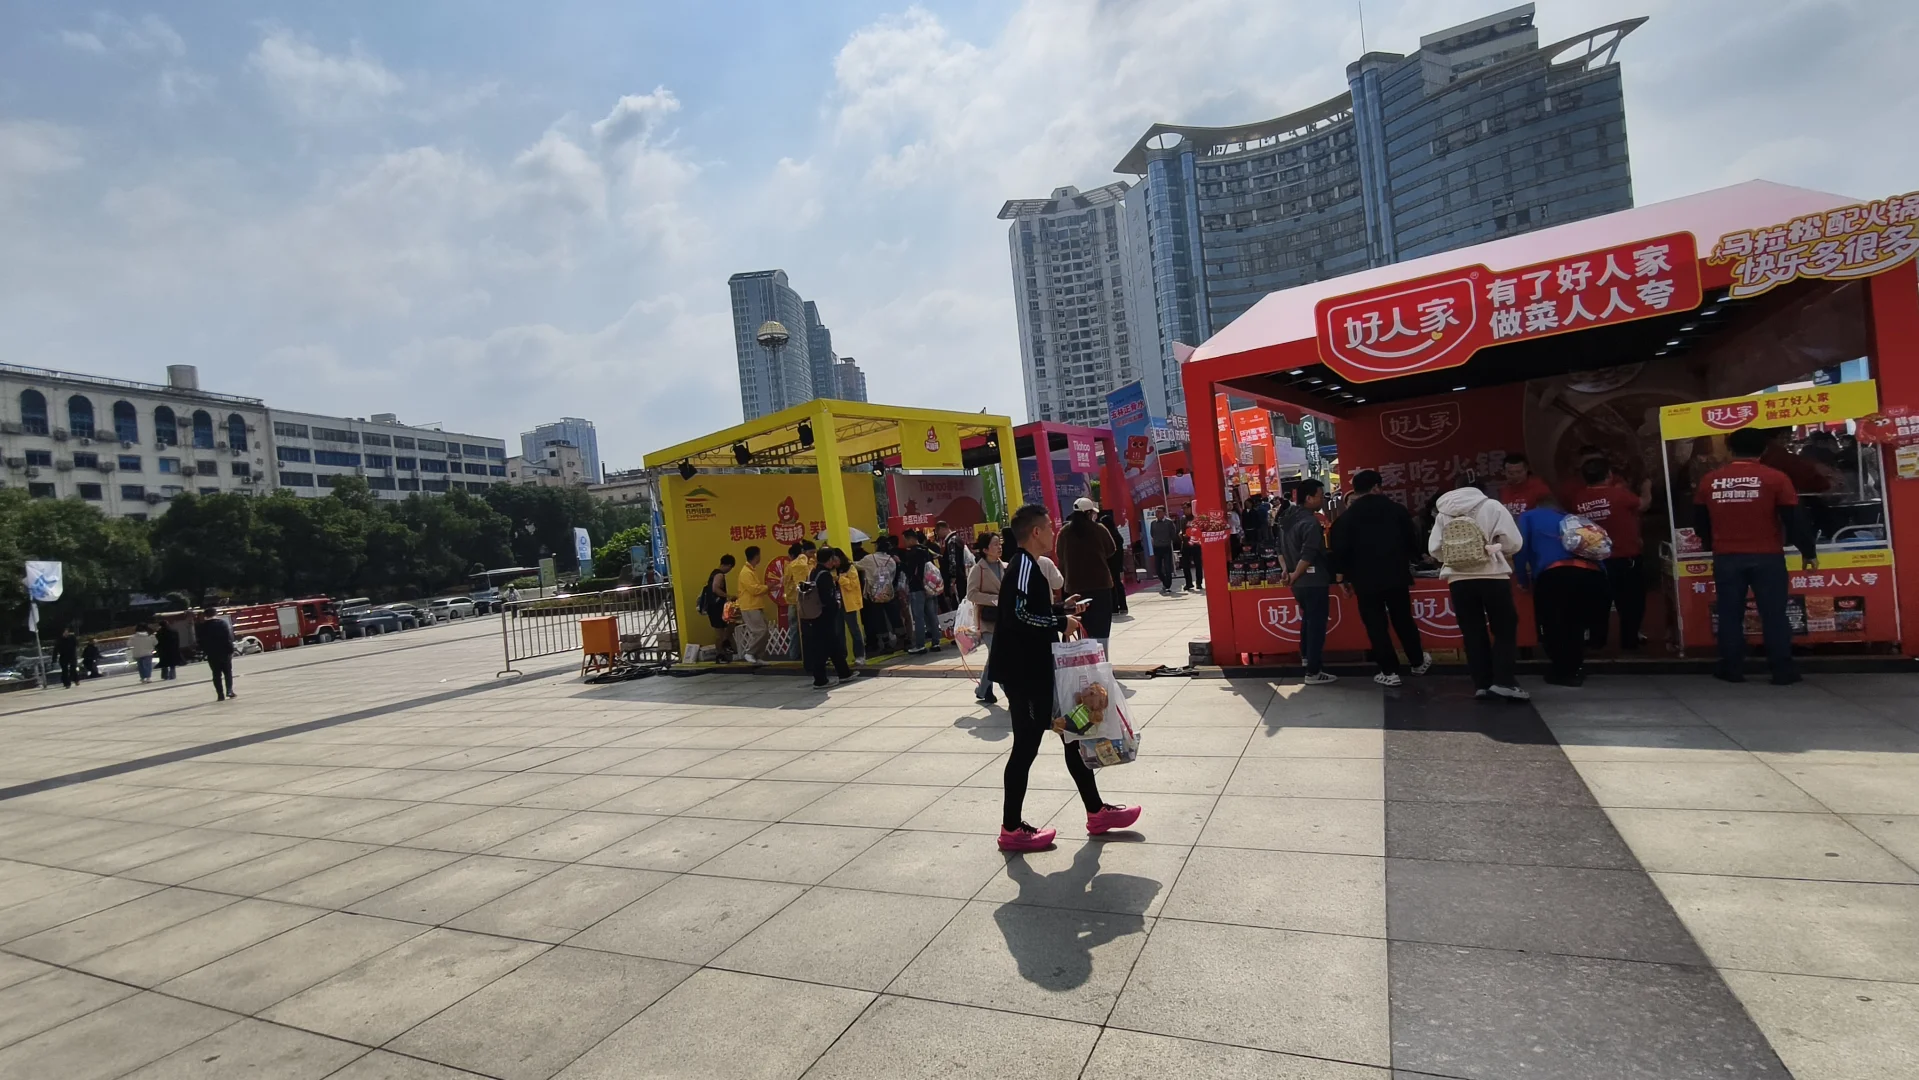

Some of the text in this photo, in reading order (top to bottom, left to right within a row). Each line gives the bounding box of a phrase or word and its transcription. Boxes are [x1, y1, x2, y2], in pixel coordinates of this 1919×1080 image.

[1734, 223, 1919, 297] 快乐多很多
[1486, 244, 1673, 307] 有了好人家
[1488, 279, 1675, 339] 做菜人人夸
[1344, 297, 1460, 349] 好人家
[1764, 392, 1829, 409] 有了好人家
[1707, 405, 1754, 423] 好人家
[1765, 404, 1831, 421] 做菜人人夸
[1389, 411, 1452, 436] 好人家
[730, 524, 767, 541] 想吃辣
[1791, 572, 1878, 589] 做菜人人夸
[1412, 598, 1456, 619] 好人
